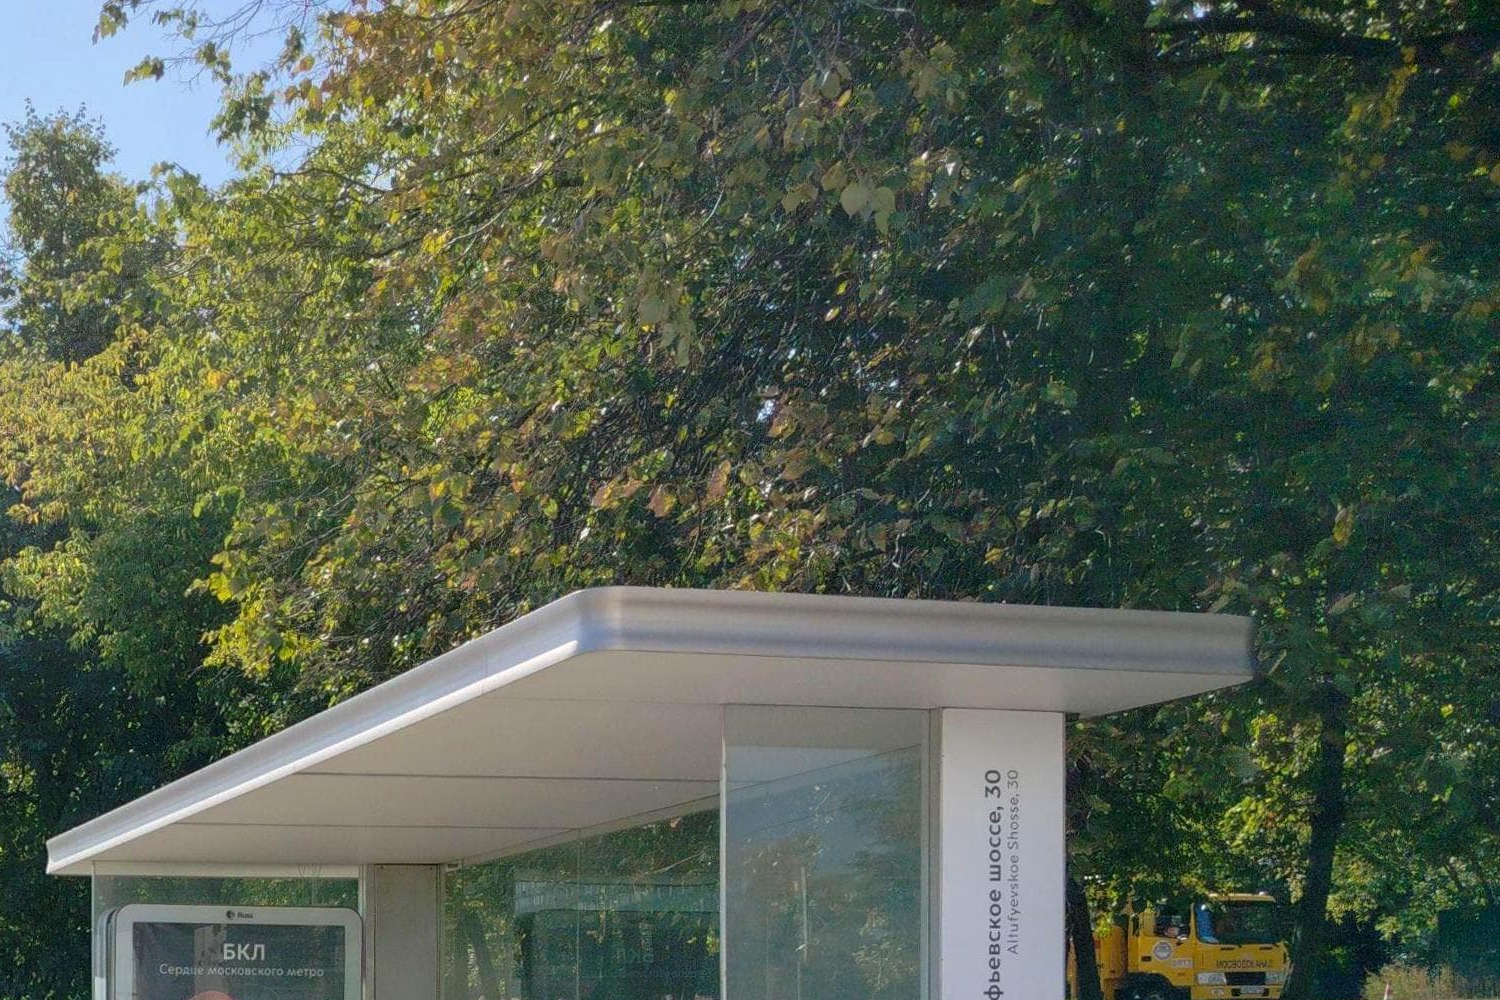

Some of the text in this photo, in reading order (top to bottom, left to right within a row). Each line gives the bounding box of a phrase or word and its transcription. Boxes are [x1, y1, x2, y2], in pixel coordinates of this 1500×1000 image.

[985, 769, 1001, 798] 30
[989, 806, 1004, 882] шоссе,
[1007, 769, 1020, 955] Altufyevskoe Shosse, 30
[223, 943, 266, 961] БКЛ
[159, 963, 325, 977] Сердце московского метро
